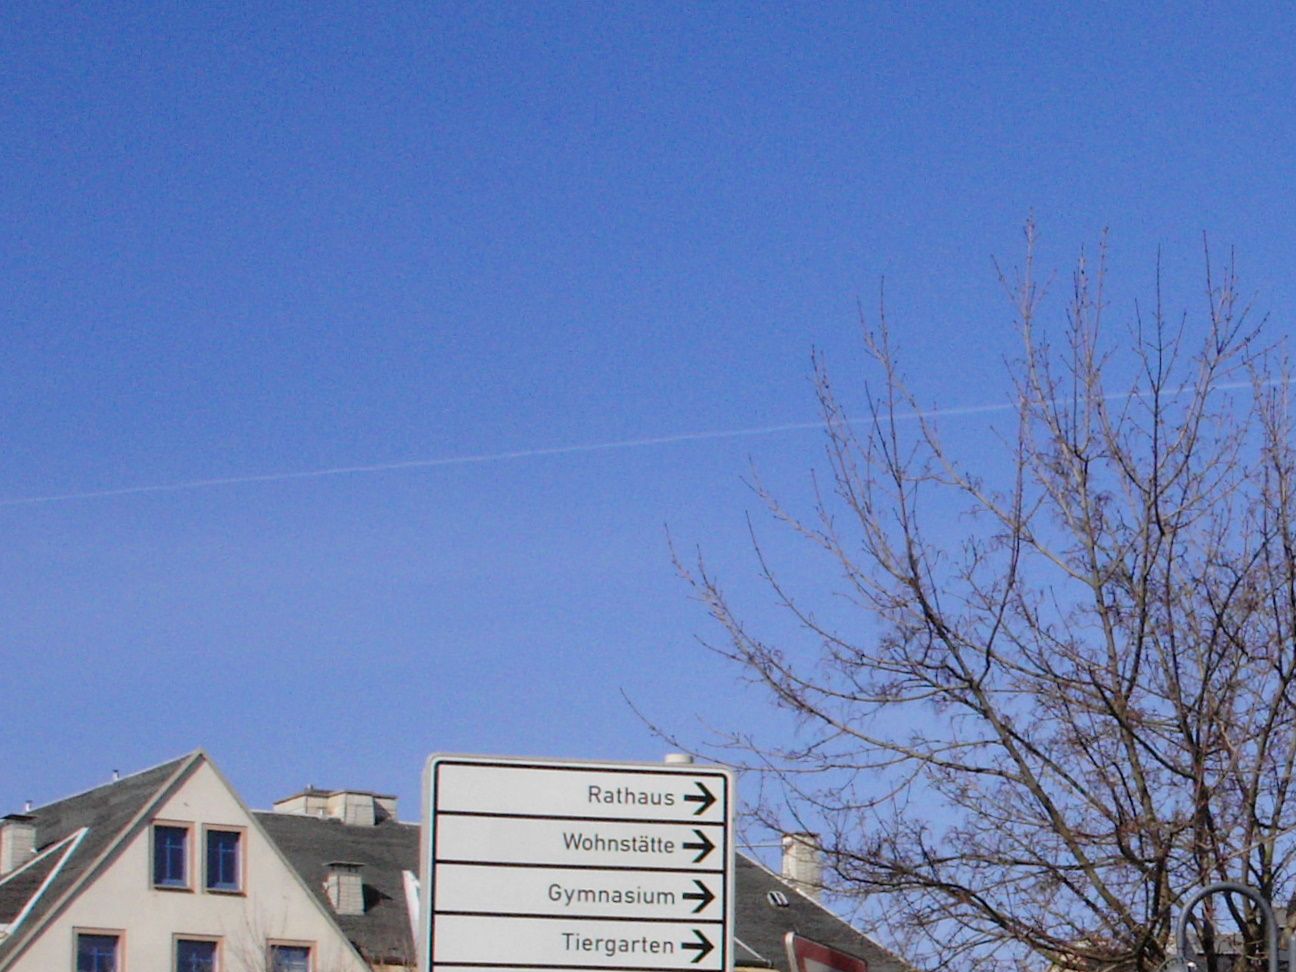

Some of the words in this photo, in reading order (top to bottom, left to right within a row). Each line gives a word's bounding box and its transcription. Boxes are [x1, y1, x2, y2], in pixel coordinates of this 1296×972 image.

[588, 785, 675, 807] Rathaus
[562, 832, 675, 854] Wohnstätte
[548, 883, 676, 907] Gymnasium
[561, 932, 674, 957] Tiergarten
